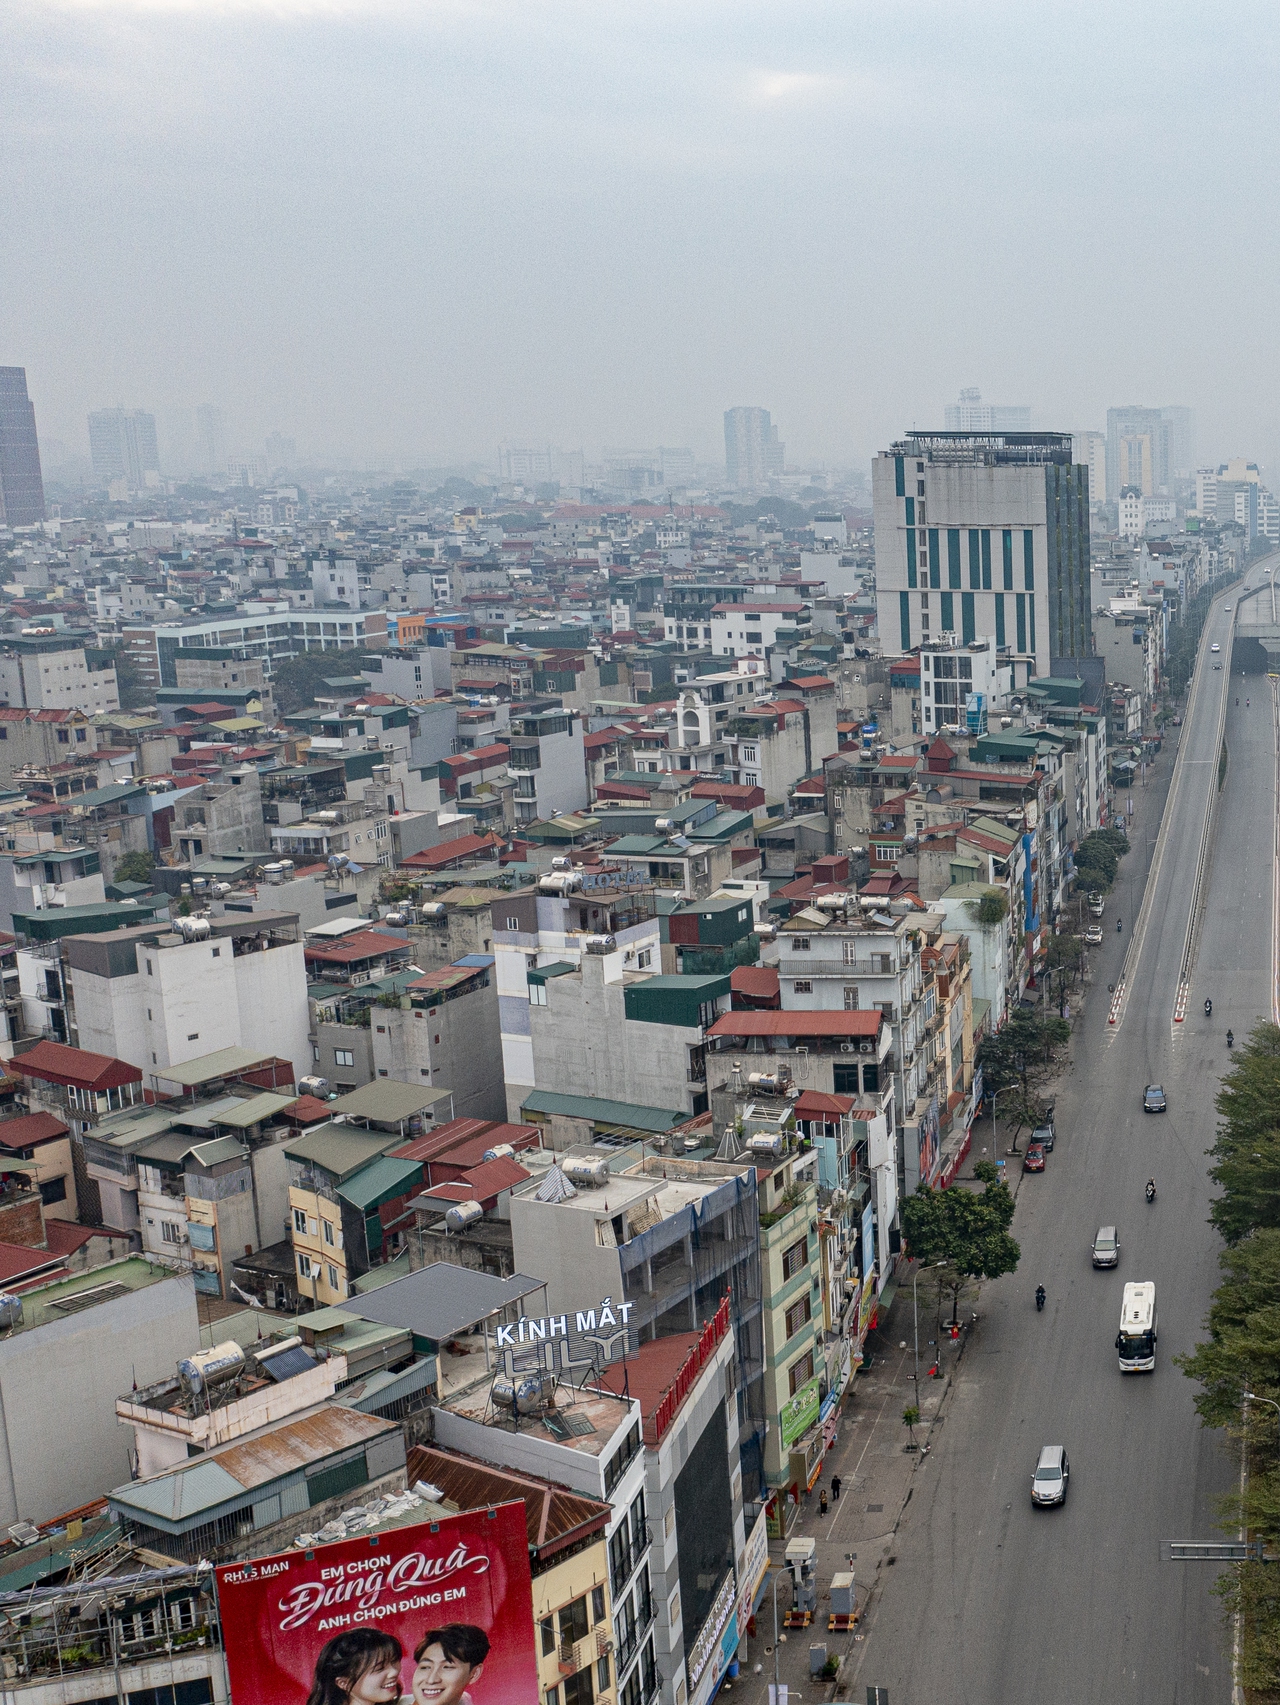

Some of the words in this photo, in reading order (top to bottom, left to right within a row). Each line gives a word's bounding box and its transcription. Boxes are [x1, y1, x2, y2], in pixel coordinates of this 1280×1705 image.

[582, 870, 652, 890] HOTEL
[496, 1315, 567, 1346] KÍNH
[575, 1296, 633, 1332] MẮT
[504, 1328, 629, 1379] LILY
[261, 1561, 290, 1576] MAN
[279, 1570, 391, 1631] Đúng
[386, 1541, 490, 1593] Quà
[321, 1564, 345, 1580] EM
[346, 1554, 391, 1577] CHỌN
[317, 1615, 351, 1631] ANH
[352, 1603, 398, 1624] CHỌN
[397, 1590, 442, 1613] ĐÚNG
[444, 1586, 466, 1602] EM
